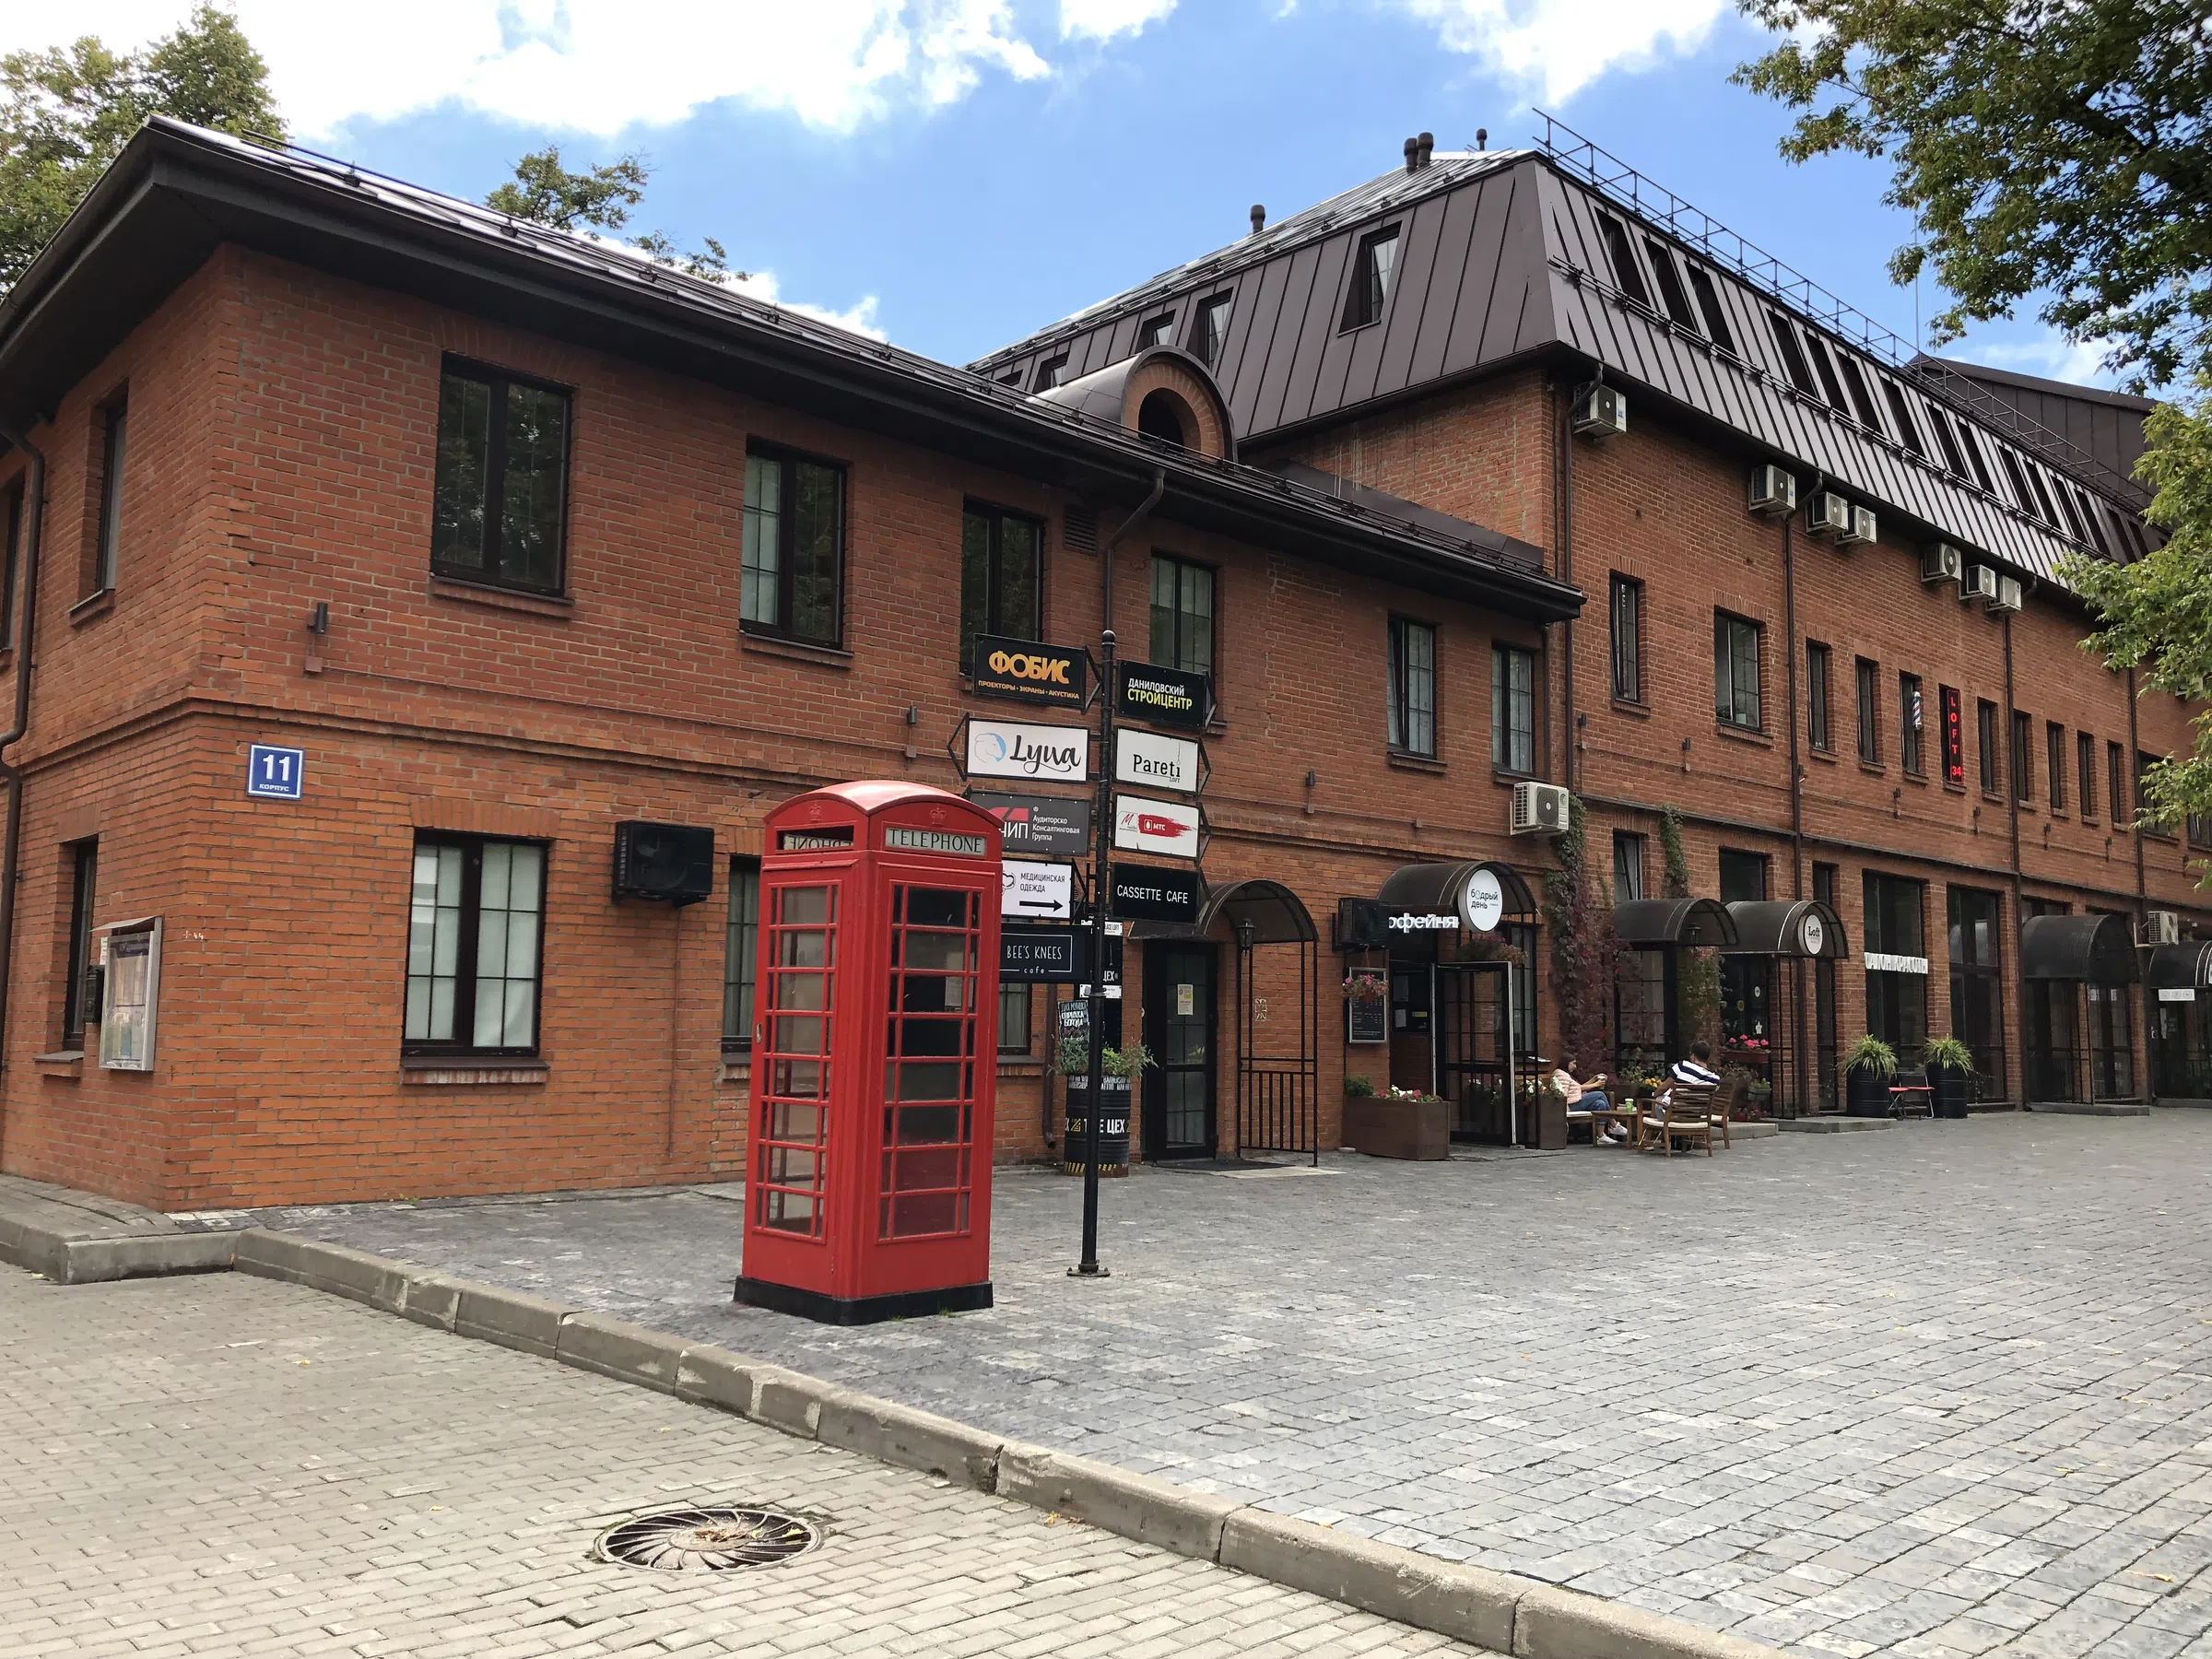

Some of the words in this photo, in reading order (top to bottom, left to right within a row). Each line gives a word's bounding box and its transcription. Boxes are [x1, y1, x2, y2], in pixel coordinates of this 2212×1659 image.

[989, 650, 1070, 684] ФОБИС
[978, 680, 1016, 690] ПРОЕКТОРЫ
[1019, 686, 1045, 695] ЭКРАНЫ
[1049, 689, 1079, 700] АКУСТИКА
[1128, 677, 1184, 697] ДАНИЛОВСКИЙ
[263, 754, 290, 782] 11
[1133, 754, 1181, 777] Pareti
[259, 783, 289, 792] КОРПУС
[1032, 815, 1067, 825] Аудиторско
[1031, 832, 1053, 841] Группа
[1032, 824, 1080, 834] Консалтинговая
[889, 829, 982, 853] TELEPHONE
[1020, 873, 1065, 883] МЕДИЦИНСКАЯ
[1019, 883, 1046, 893] ОДЕЖДА
[1116, 885, 1161, 900] CASSETTE
[1166, 890, 1189, 904] CAFE
[1471, 900, 1488, 910] день
[1389, 912, 1458, 933] офейня
[1006, 945, 1030, 959] BEE'S
[1034, 946, 1062, 959] KNEES
[1023, 965, 1044, 974] cafe
[1107, 1119, 1125, 1135] ЦЕХ
